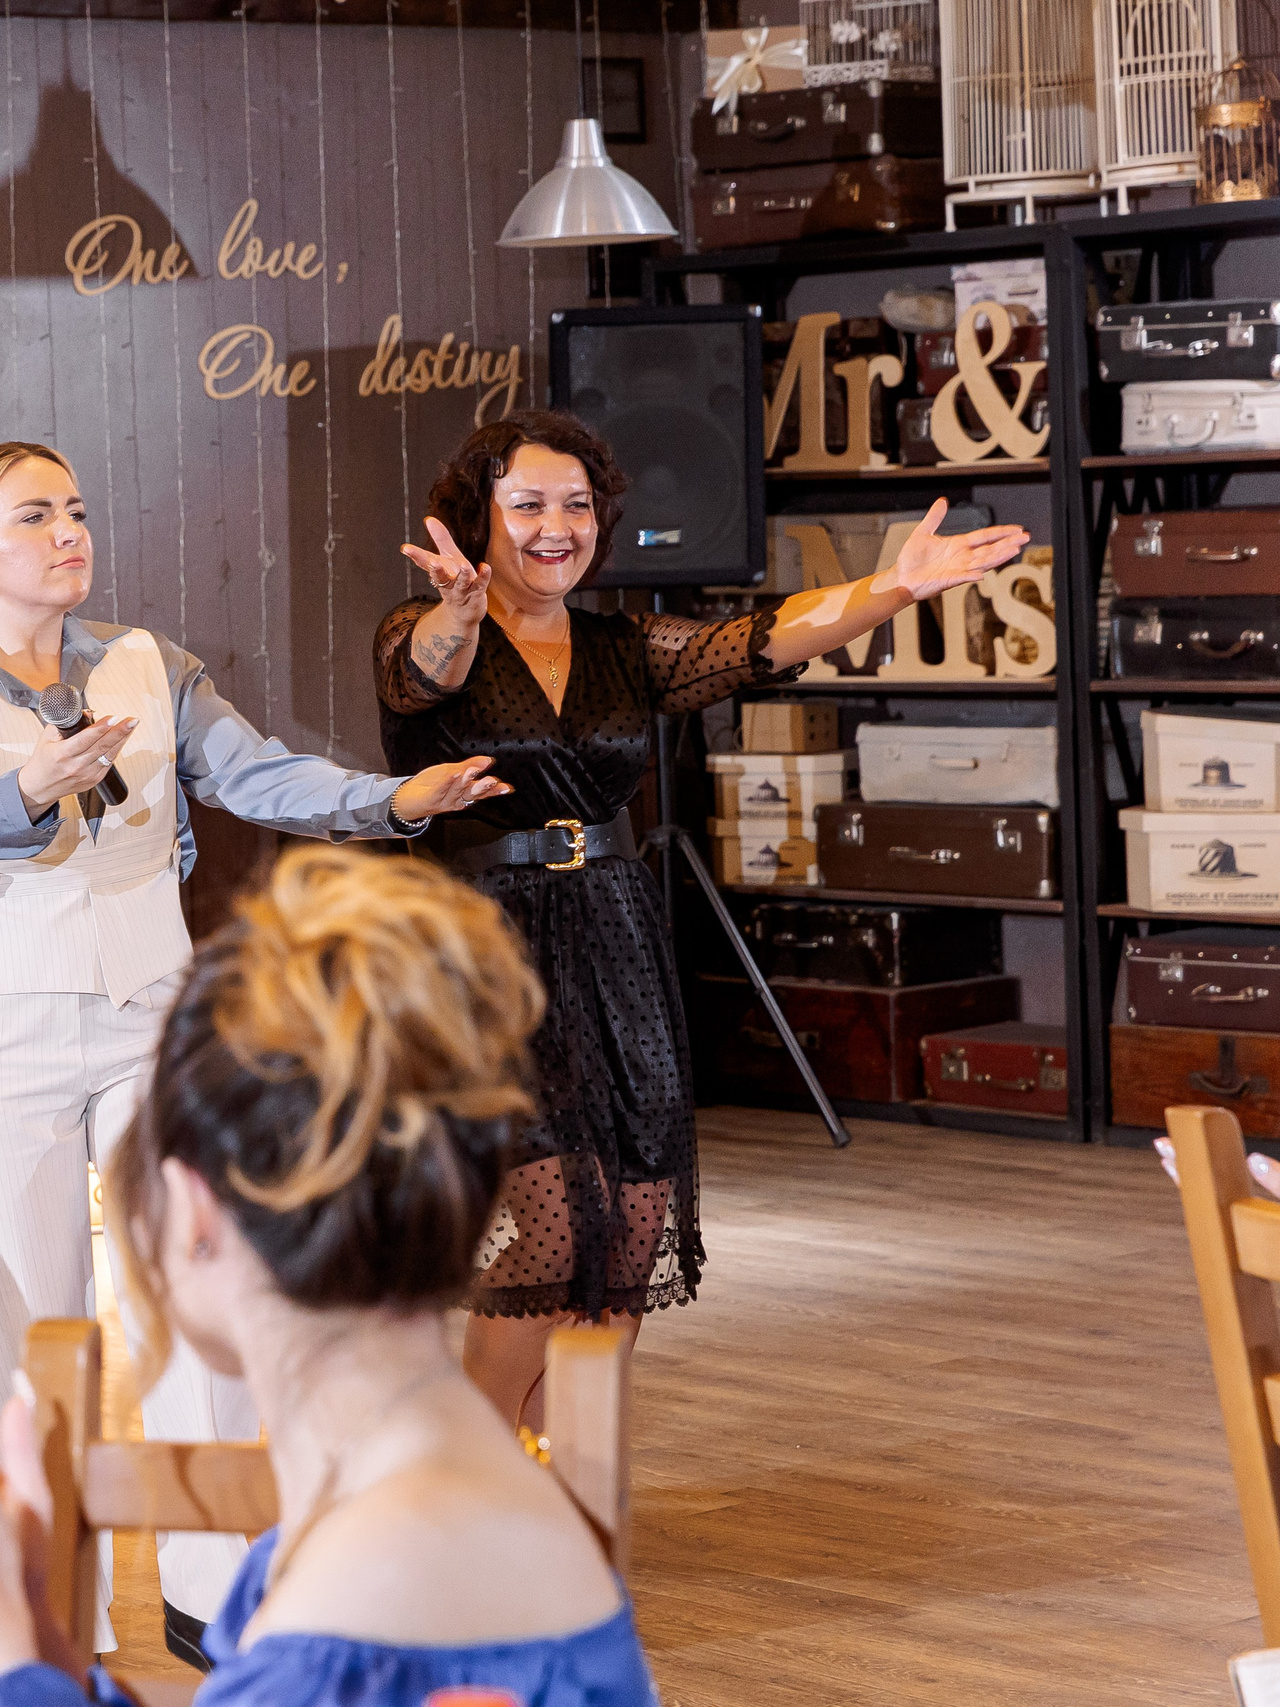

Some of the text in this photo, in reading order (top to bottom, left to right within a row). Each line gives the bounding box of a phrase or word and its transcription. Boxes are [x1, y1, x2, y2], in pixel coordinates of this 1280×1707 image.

[65, 198, 350, 297] One love,
[198, 314, 523, 430] One destiny
